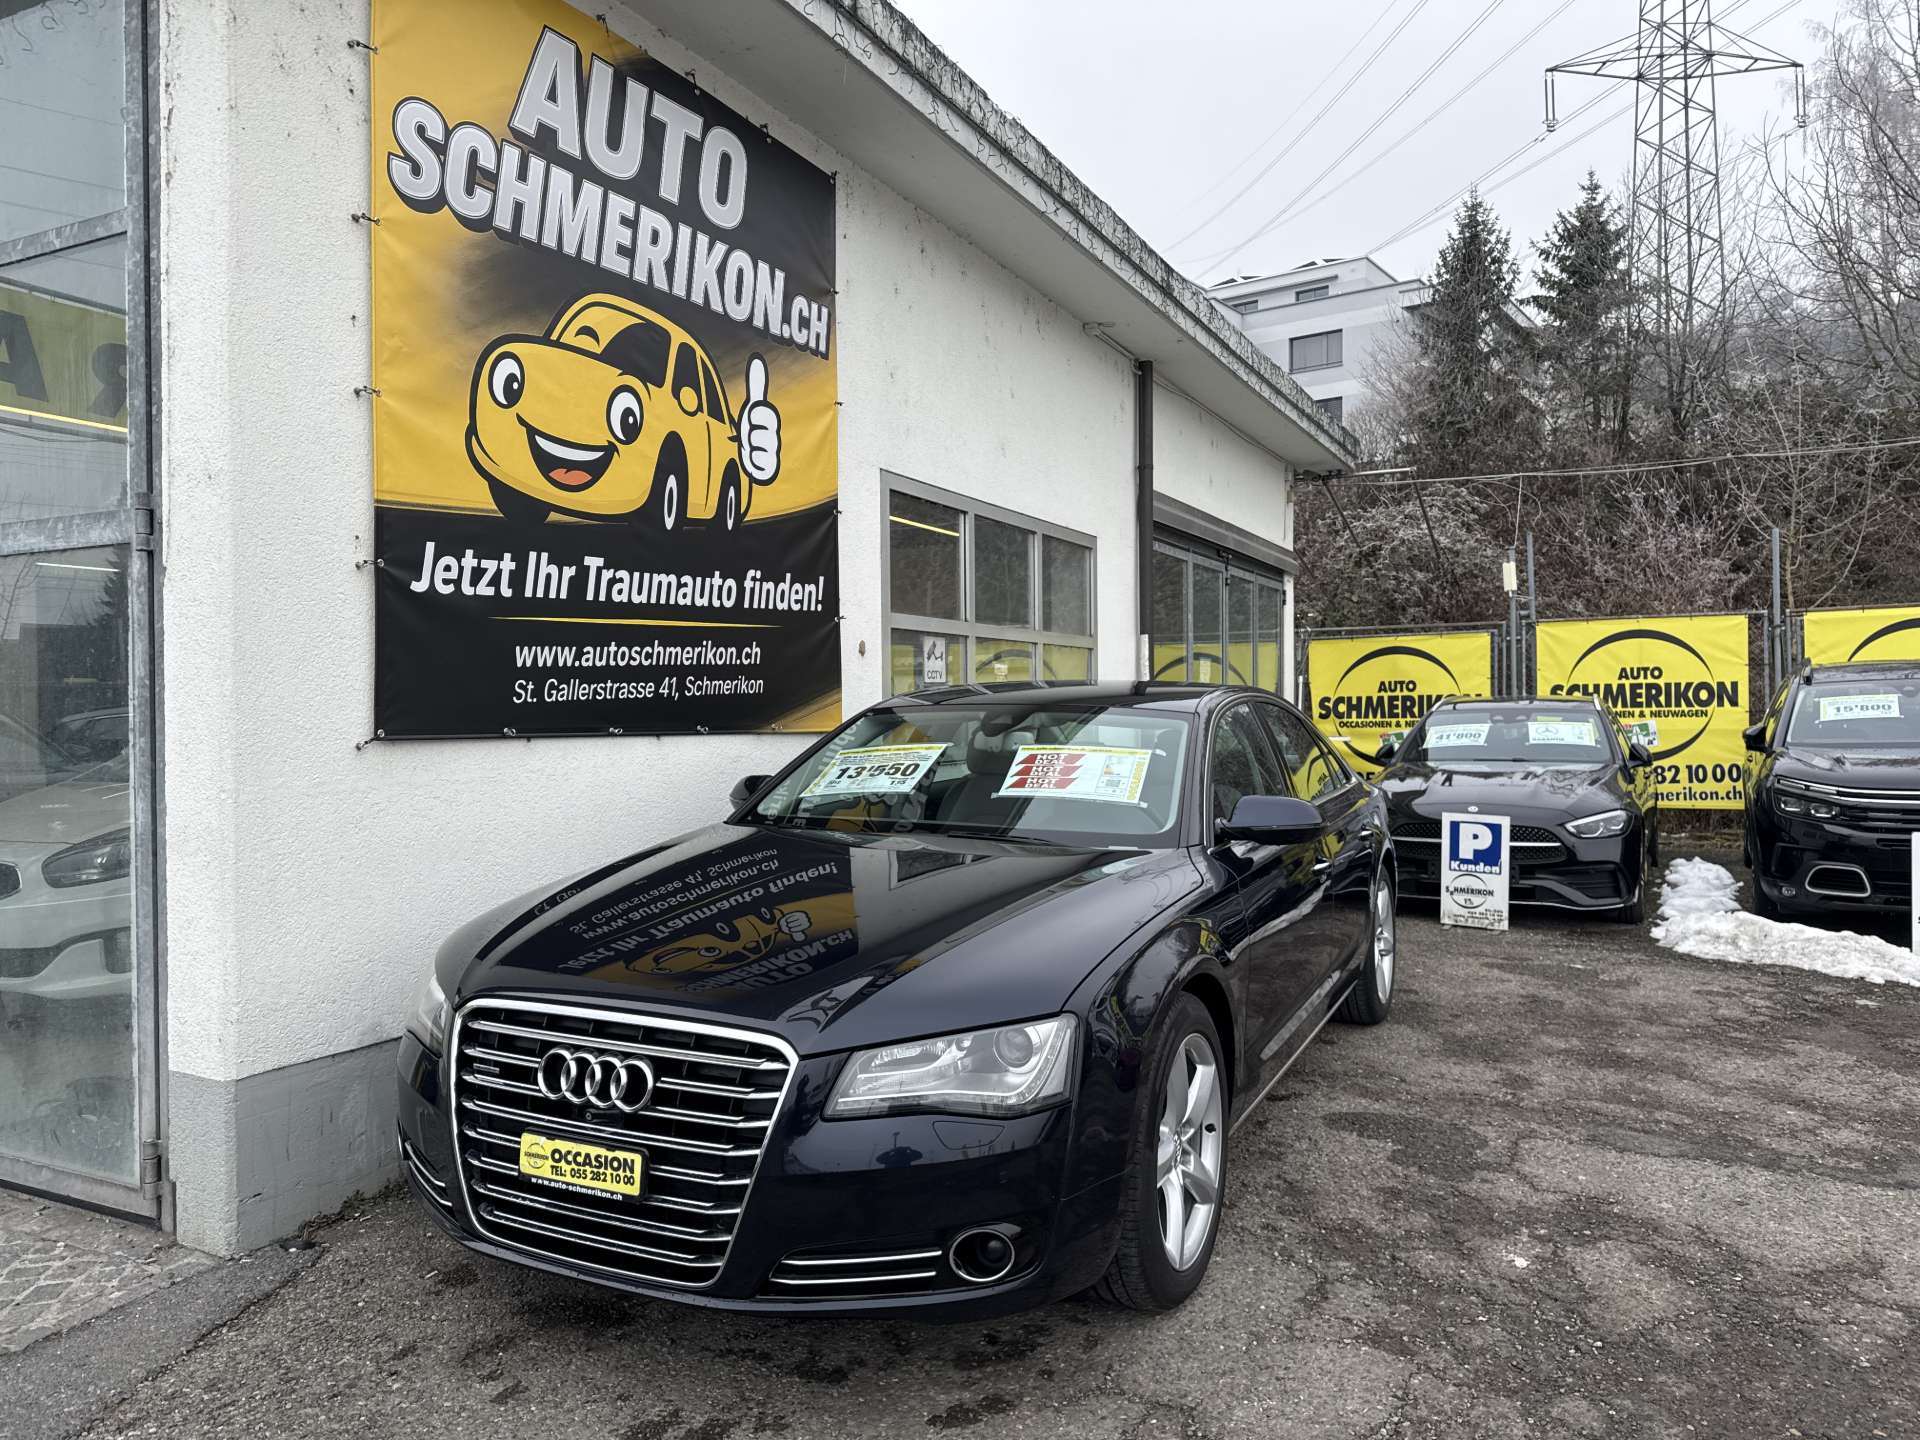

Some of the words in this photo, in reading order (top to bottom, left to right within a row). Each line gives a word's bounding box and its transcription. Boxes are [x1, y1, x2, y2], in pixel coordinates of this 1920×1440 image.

[511, 26, 748, 231] AUTO
[389, 98, 830, 358] SCHMERIKON.CH
[410, 541, 516, 598] Jetzt
[524, 551, 576, 599] Ihr
[583, 556, 737, 608] Traumauto
[743, 569, 825, 612] finden!
[515, 640, 761, 668] www.autoschmerikon.ch
[927, 670, 943, 680] CCTV
[1618, 666, 1663, 681] AUTO
[513, 680, 537, 703] St.
[544, 678, 655, 702] Gallerstrasse
[659, 677, 679, 701] 41,
[684, 675, 764, 697] Schmerikon
[1378, 680, 1417, 694] AUTO
[1638, 710, 1646, 718] &
[1650, 709, 1708, 718] NEUWAGEN
[1339, 720, 1392, 729] OCCASIONEN
[1395, 720, 1402, 728] &
[834, 762, 921, 780] 13'550
[1686, 764, 1708, 784] 10
[1711, 763, 1742, 783] 00
[1458, 822, 1493, 860] P
[1450, 860, 1501, 874] Kunden
[550, 1148, 635, 1174] OCCASION
[550, 1165, 567, 1177] TEL:
[569, 1168, 588, 1180] 055
[589, 1171, 608, 1183] 282
[610, 1173, 622, 1185] 10
[623, 1174, 635, 1186] 00
[531, 1177, 623, 1201] www.auto-schmerikon.ch
